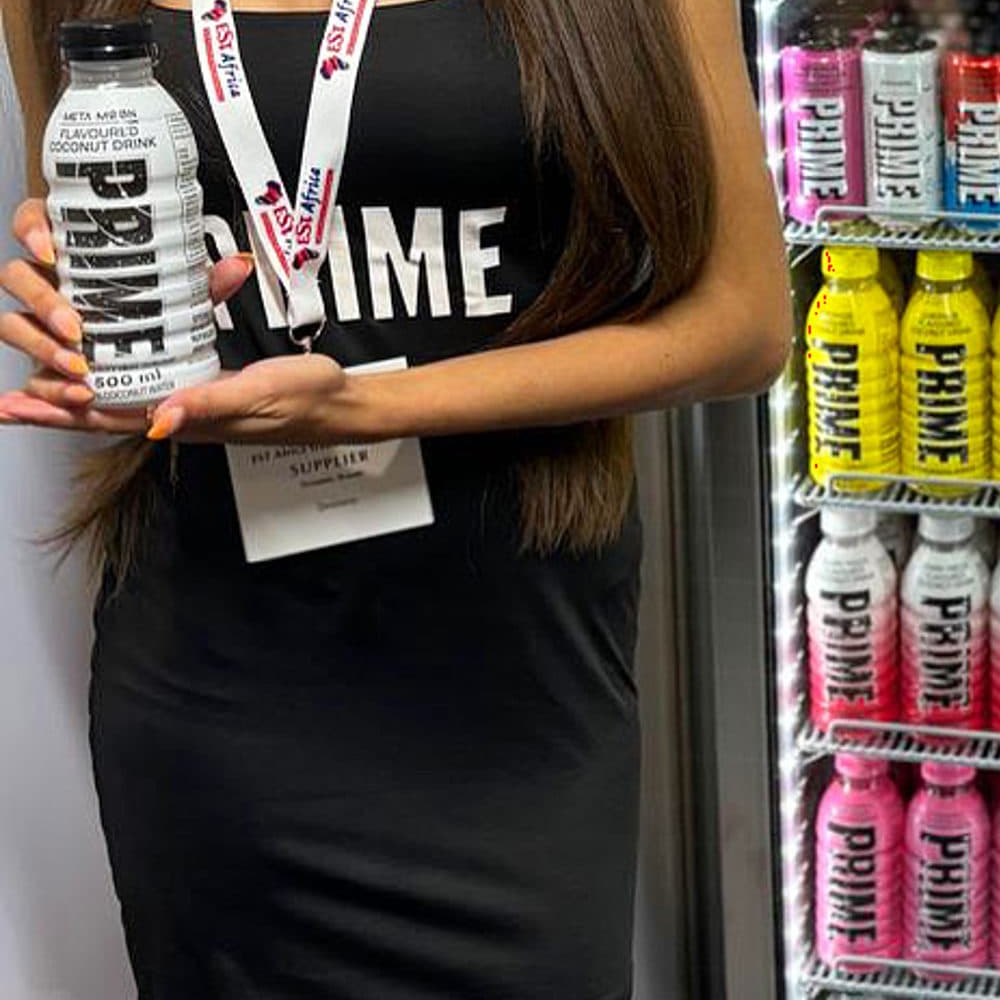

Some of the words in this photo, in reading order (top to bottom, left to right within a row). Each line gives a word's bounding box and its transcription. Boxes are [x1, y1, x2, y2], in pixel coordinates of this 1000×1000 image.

[218, 53, 241, 99] Africa
[50, 141, 109, 153] COCONUT
[112, 136, 157, 151] DRINK
[300, 167, 321, 214] Africa
[797, 96, 850, 200] PRIME
[872, 91, 923, 200] PRIME
[55, 158, 165, 364] PRIME
[94, 375, 133, 389] 500
[813, 343, 862, 460] PRIME
[915, 343, 968, 465] PRIME
[289, 450, 369, 477] SUPPLIER
[820, 589, 874, 703] PRIME
[920, 595, 971, 711] PRIME
[829, 822, 876, 942] PRIME
[919, 832, 970, 948] PRIME
